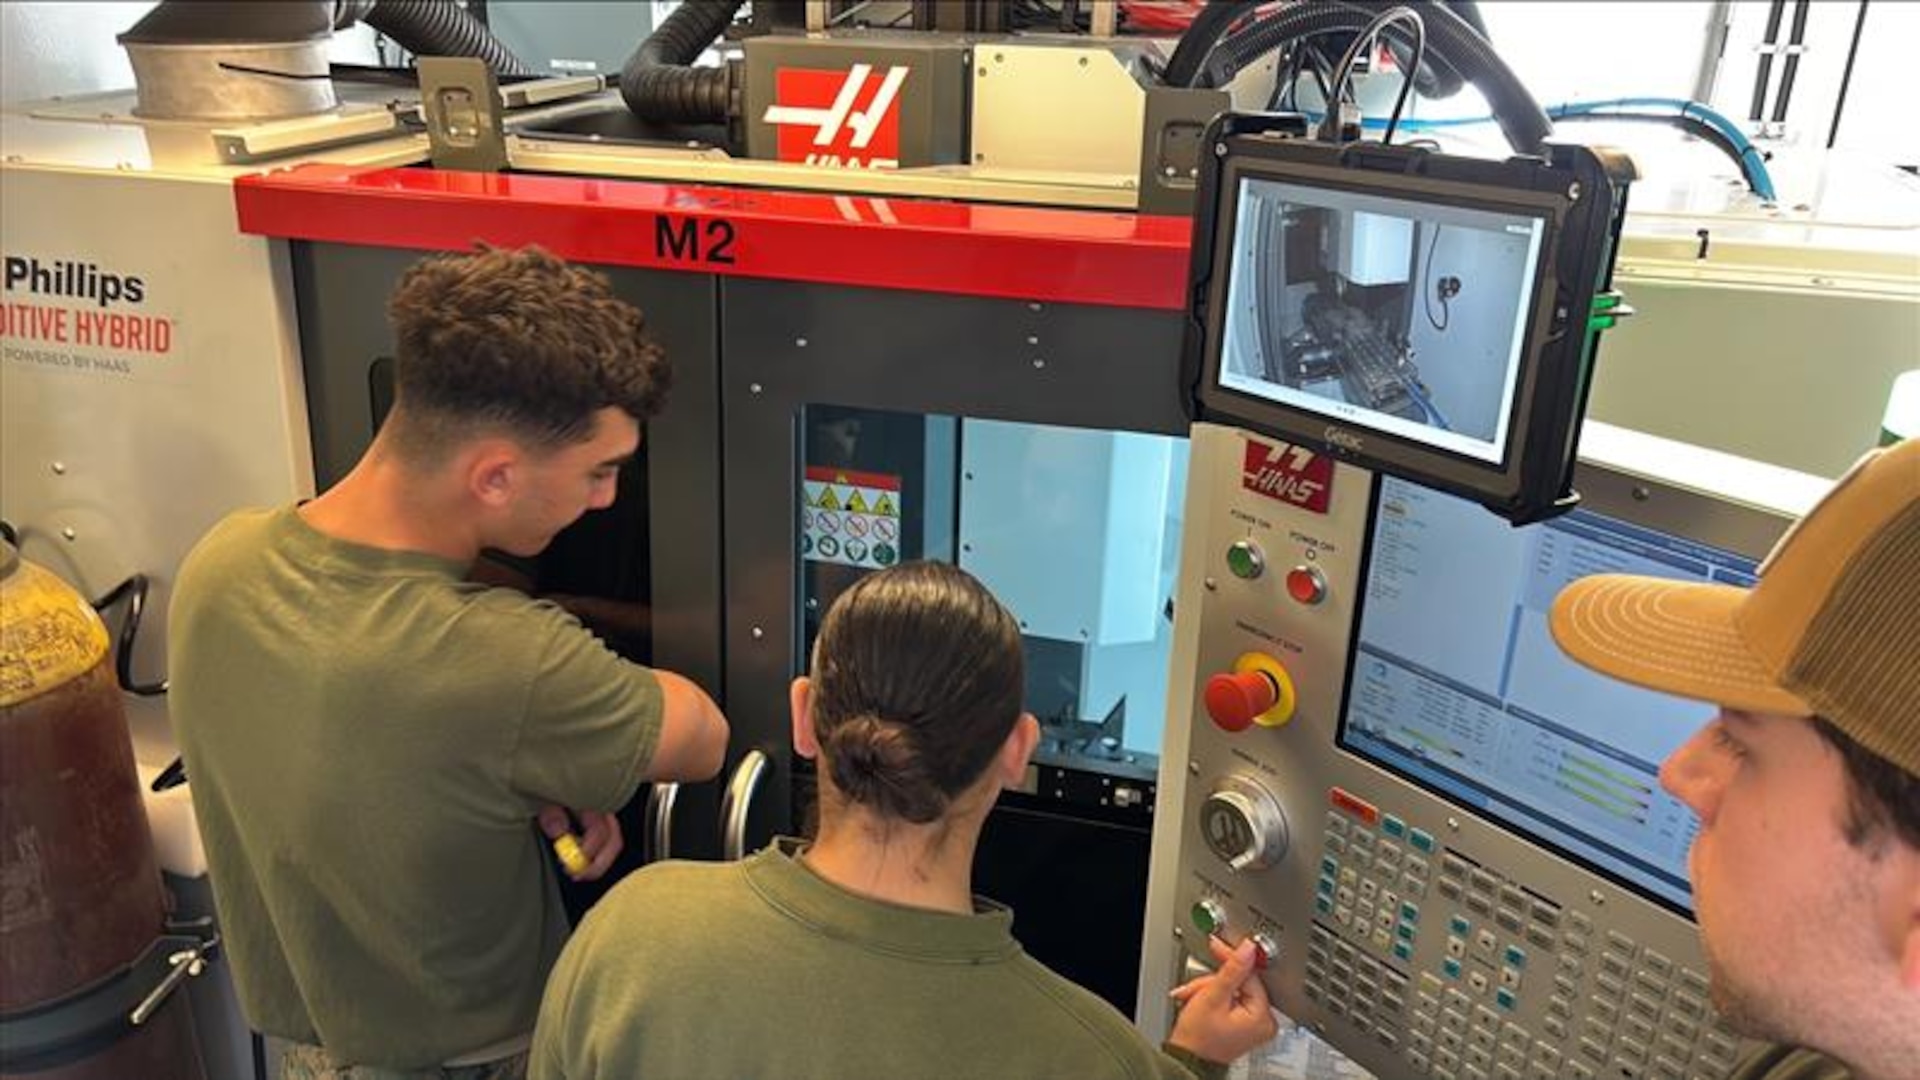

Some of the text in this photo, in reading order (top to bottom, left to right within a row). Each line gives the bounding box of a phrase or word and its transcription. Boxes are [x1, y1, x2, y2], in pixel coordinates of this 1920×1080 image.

[655, 215, 735, 264] M2
[5, 256, 144, 307] Phillips
[75, 309, 170, 353] HYBRID
[4, 347, 70, 366] POWERED
[1243, 466, 1324, 502] HAAS
